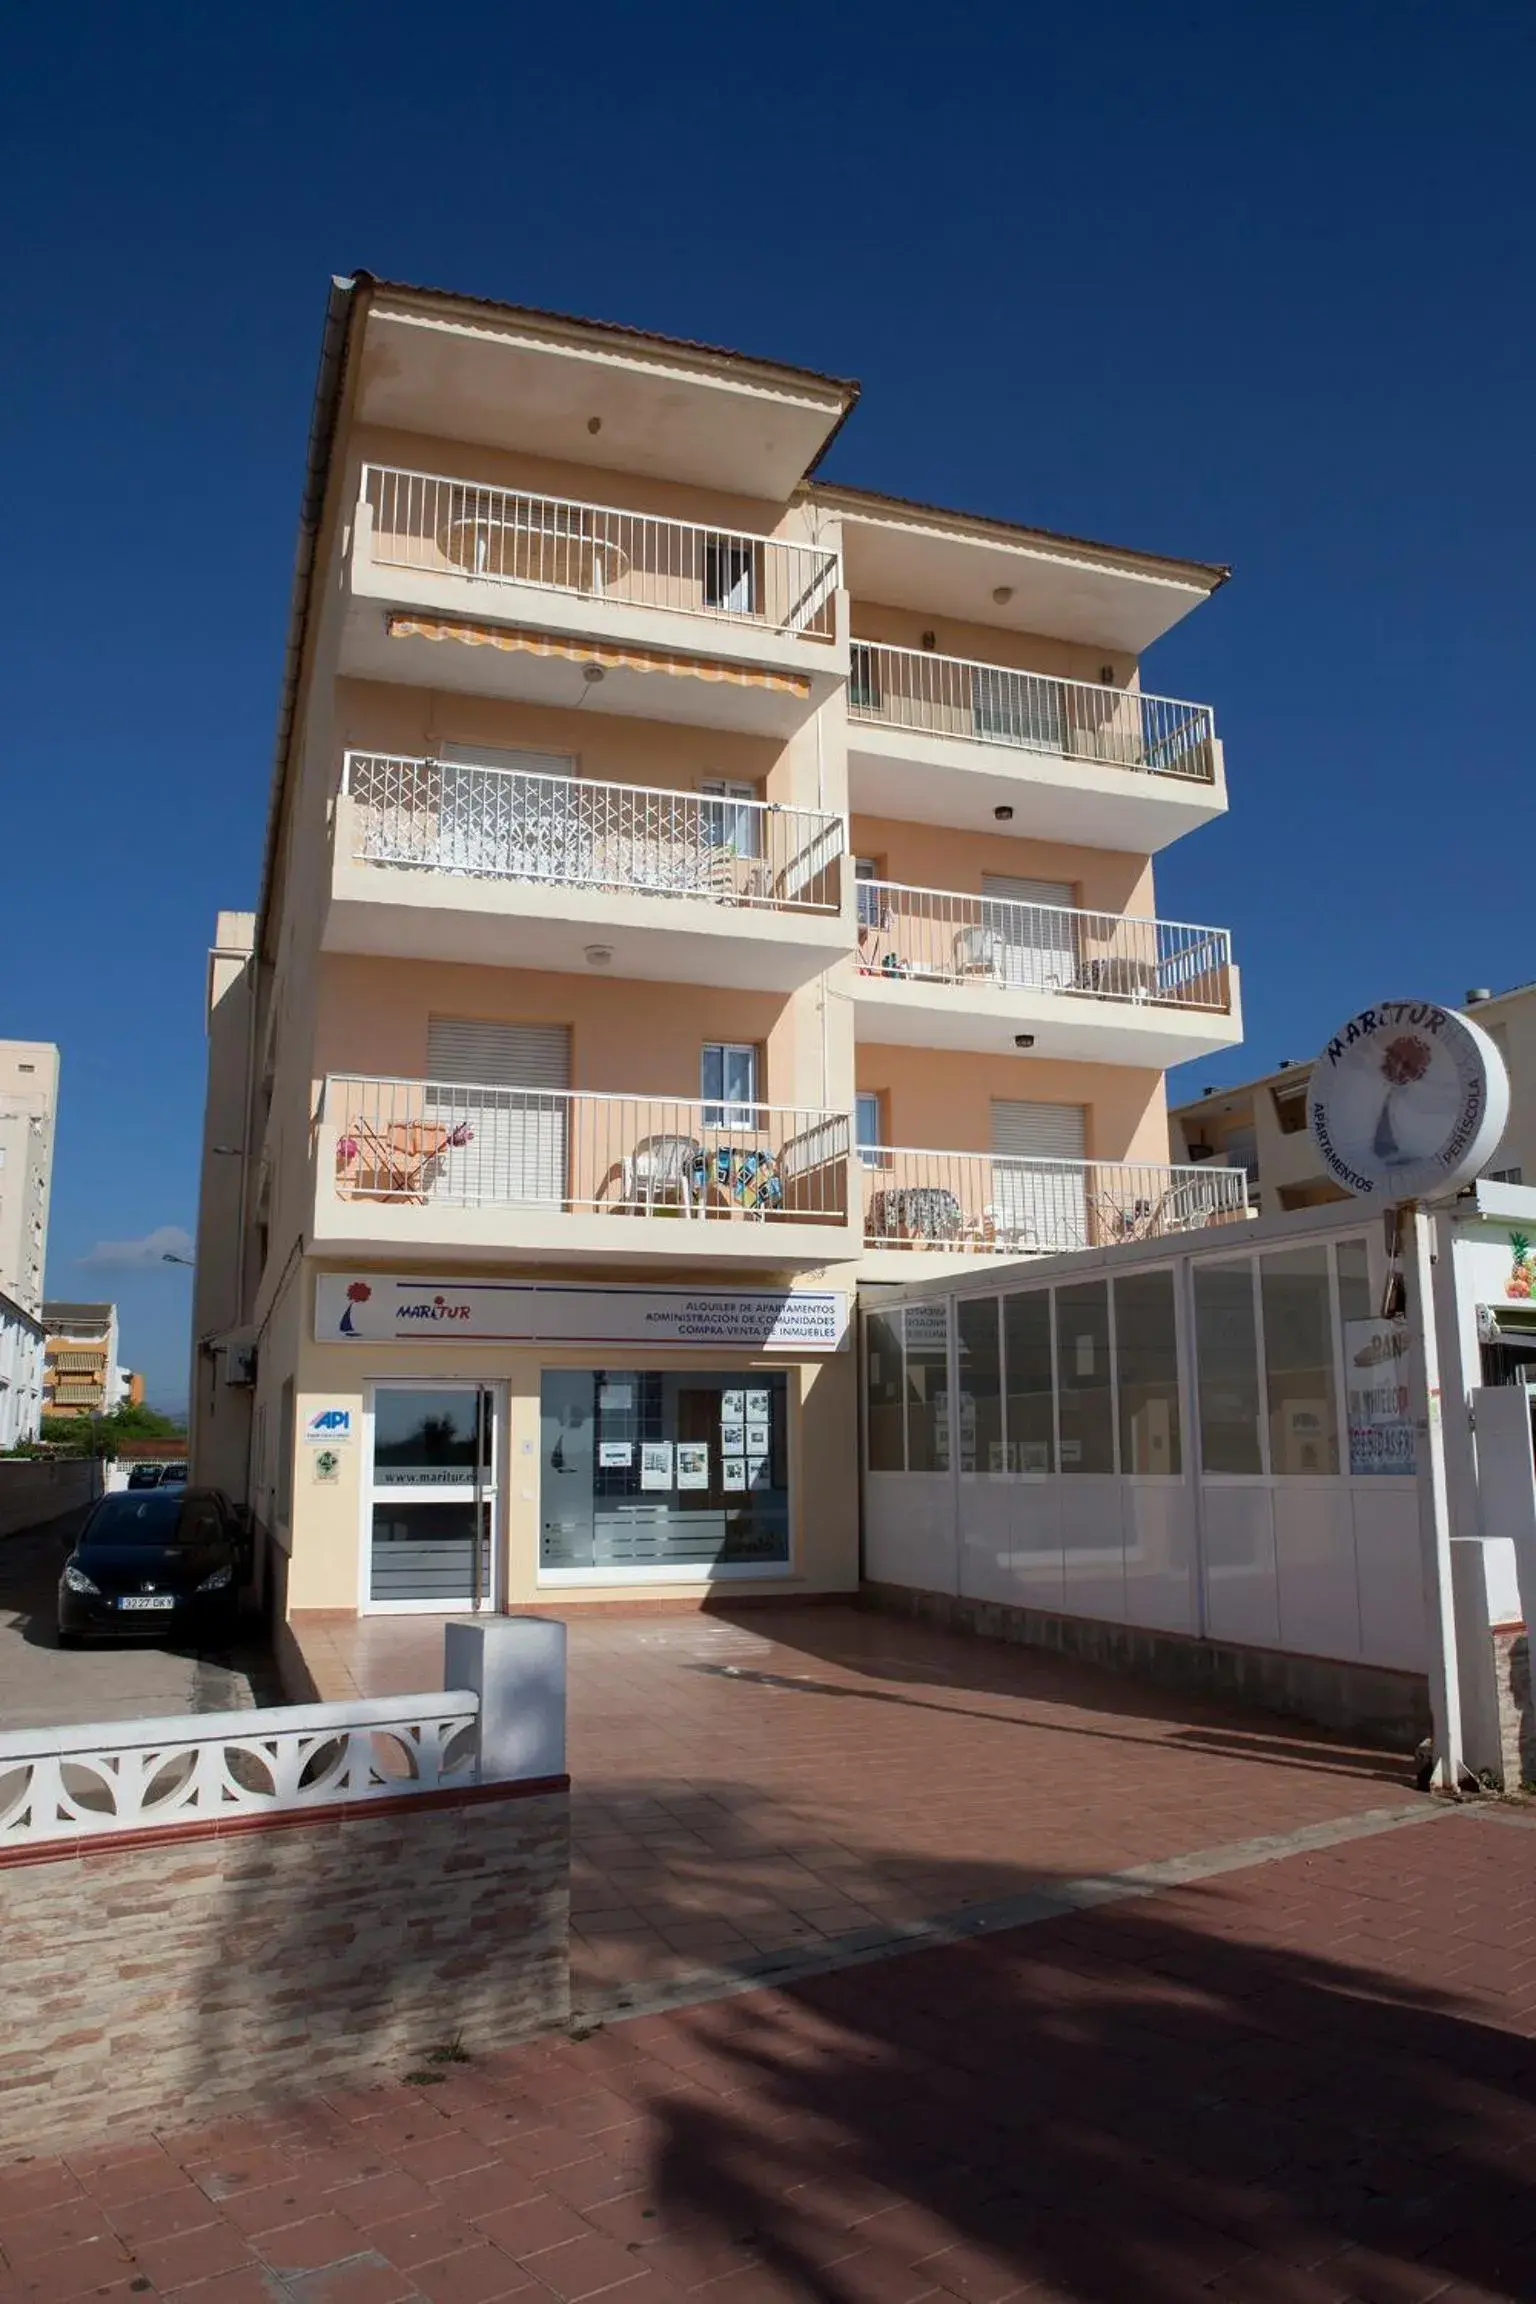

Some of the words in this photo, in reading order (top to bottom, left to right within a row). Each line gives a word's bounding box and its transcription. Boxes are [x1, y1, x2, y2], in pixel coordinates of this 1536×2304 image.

[1313, 1102, 1375, 1193] APARTAMENTOS
[686, 1301, 736, 1312] ALQUILER
[739, 1303, 752, 1313] DE
[754, 1303, 836, 1314] APARTAMENTOS
[741, 1315, 755, 1324] DE
[758, 1315, 836, 1326] COMUNIDADES
[764, 1327, 777, 1336] DE
[779, 1327, 836, 1337] INMUEBLES
[312, 1411, 350, 1429] API
[126, 1598, 151, 1608] 3227
